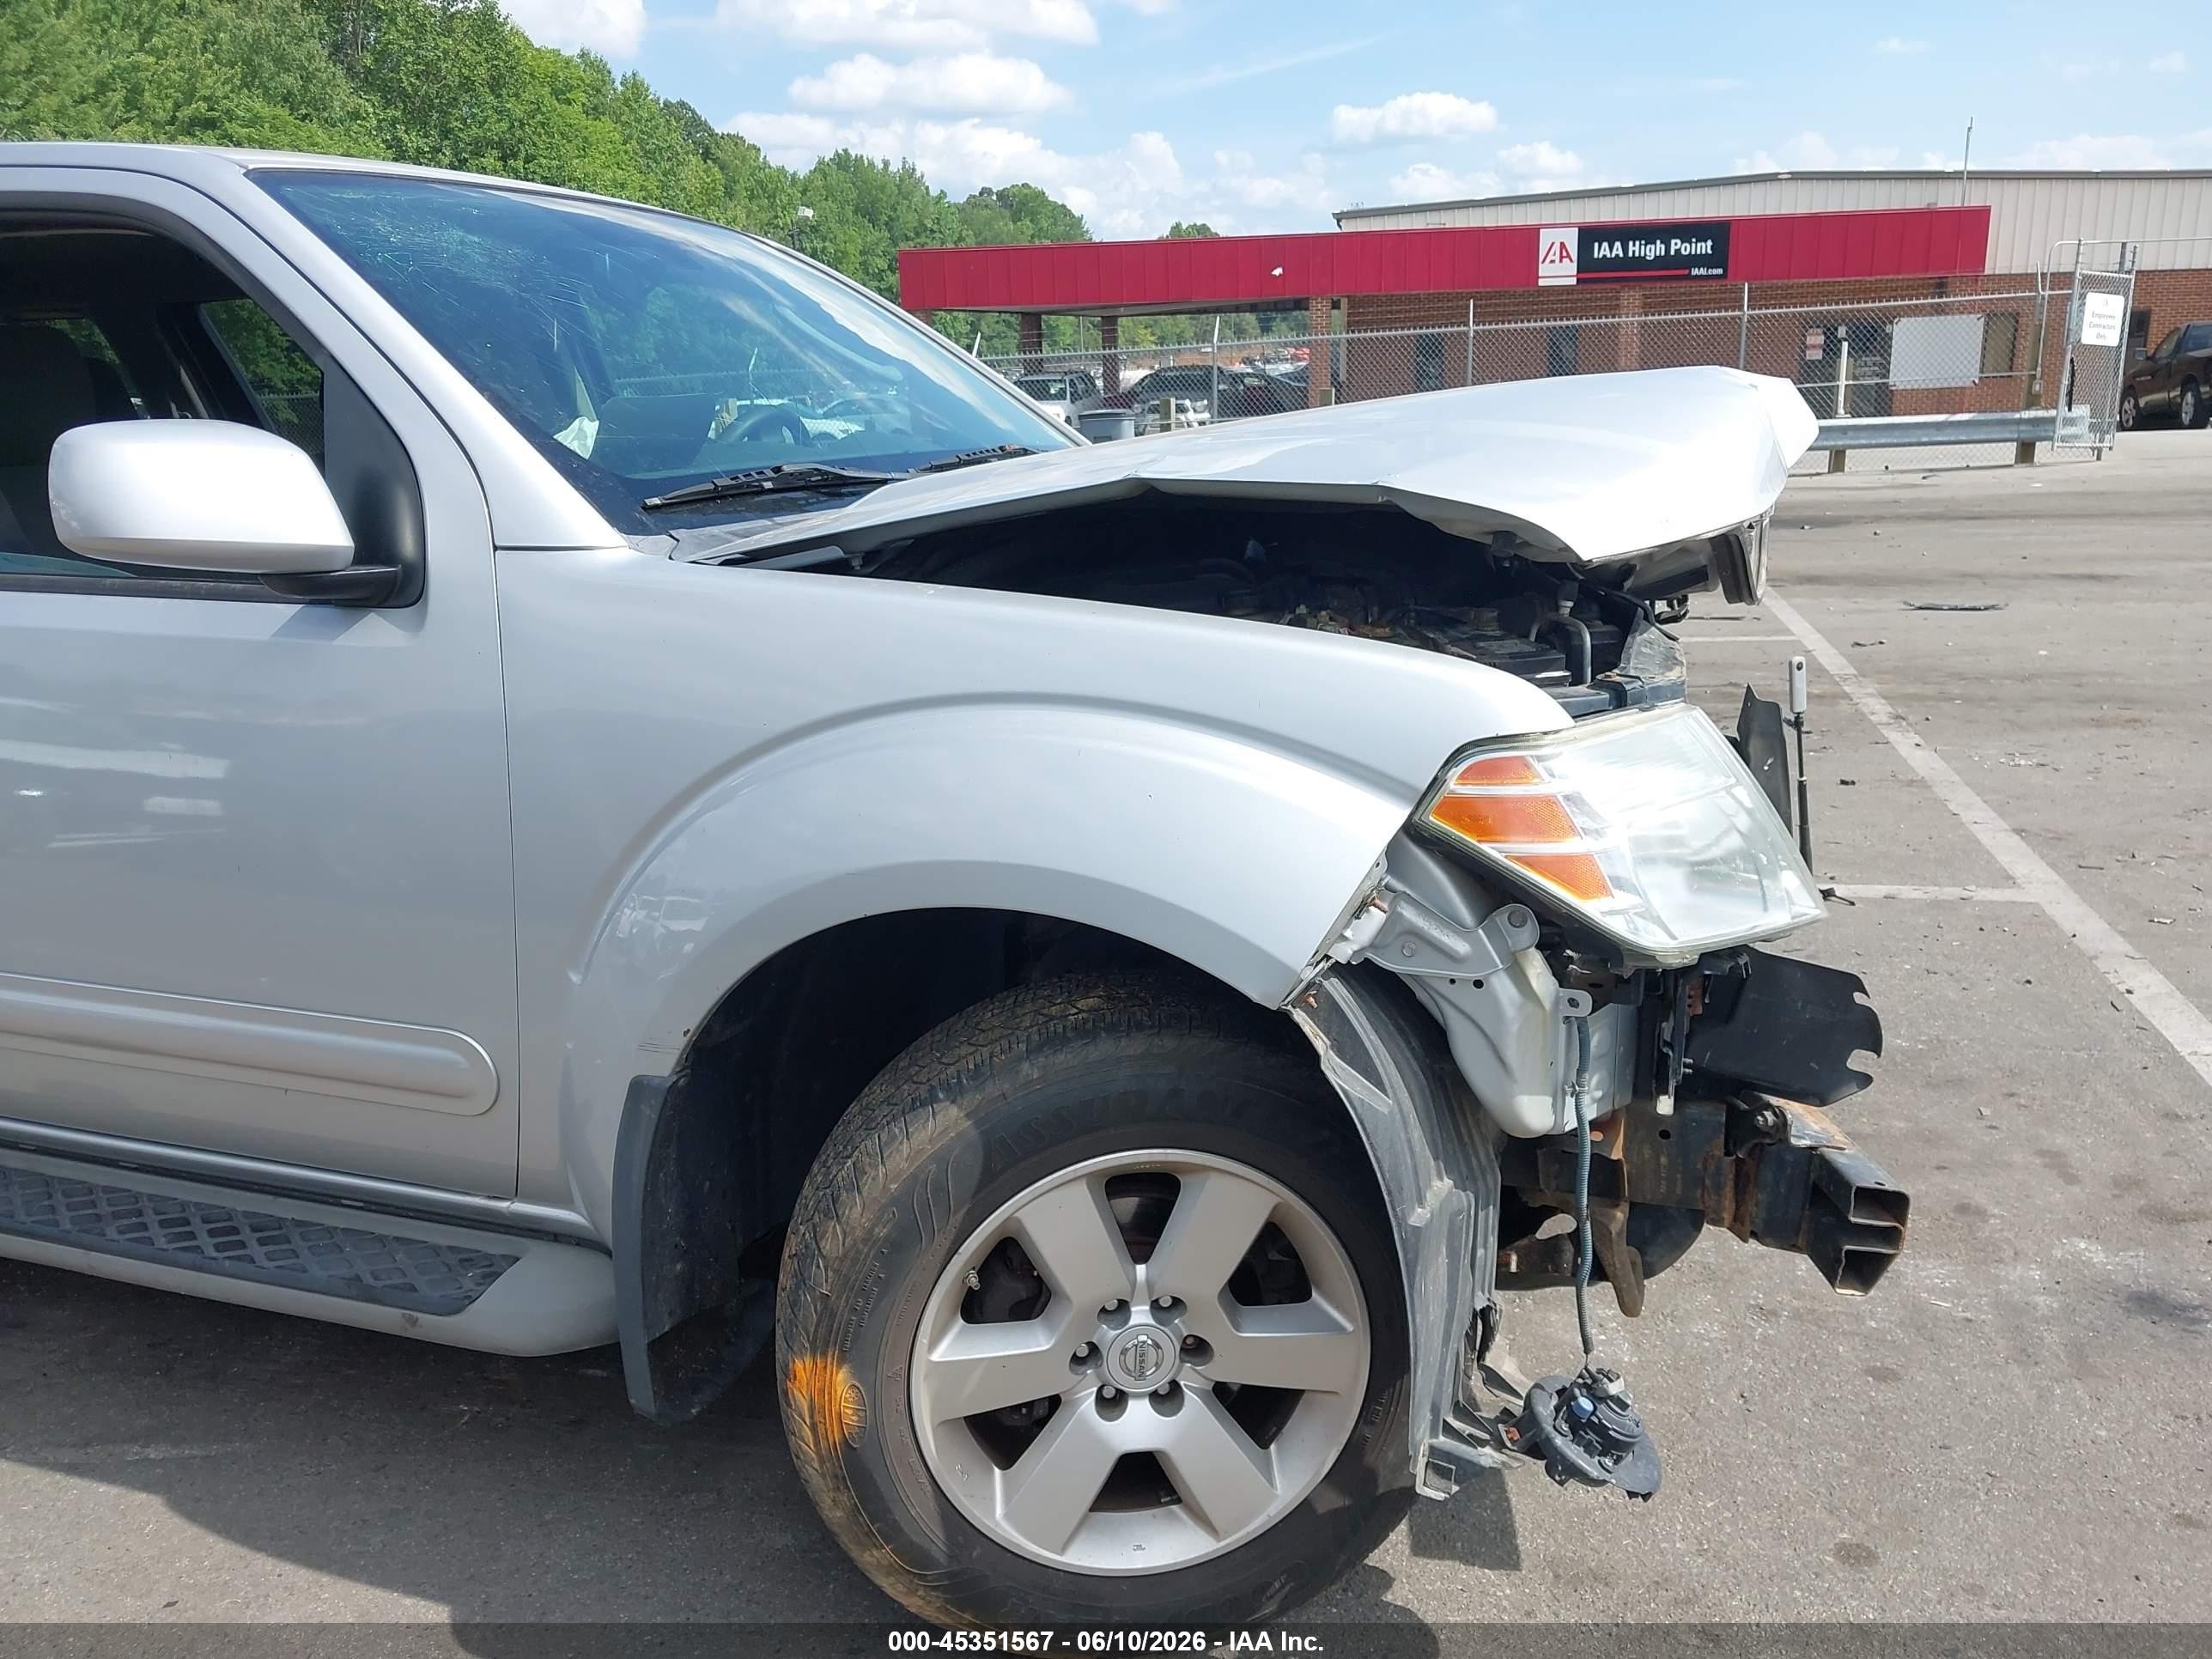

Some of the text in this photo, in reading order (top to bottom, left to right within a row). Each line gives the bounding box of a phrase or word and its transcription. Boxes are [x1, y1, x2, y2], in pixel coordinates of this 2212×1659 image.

[1594, 239, 1713, 261] IAA High Point
[1138, 1341, 1147, 1377] NISSAN
